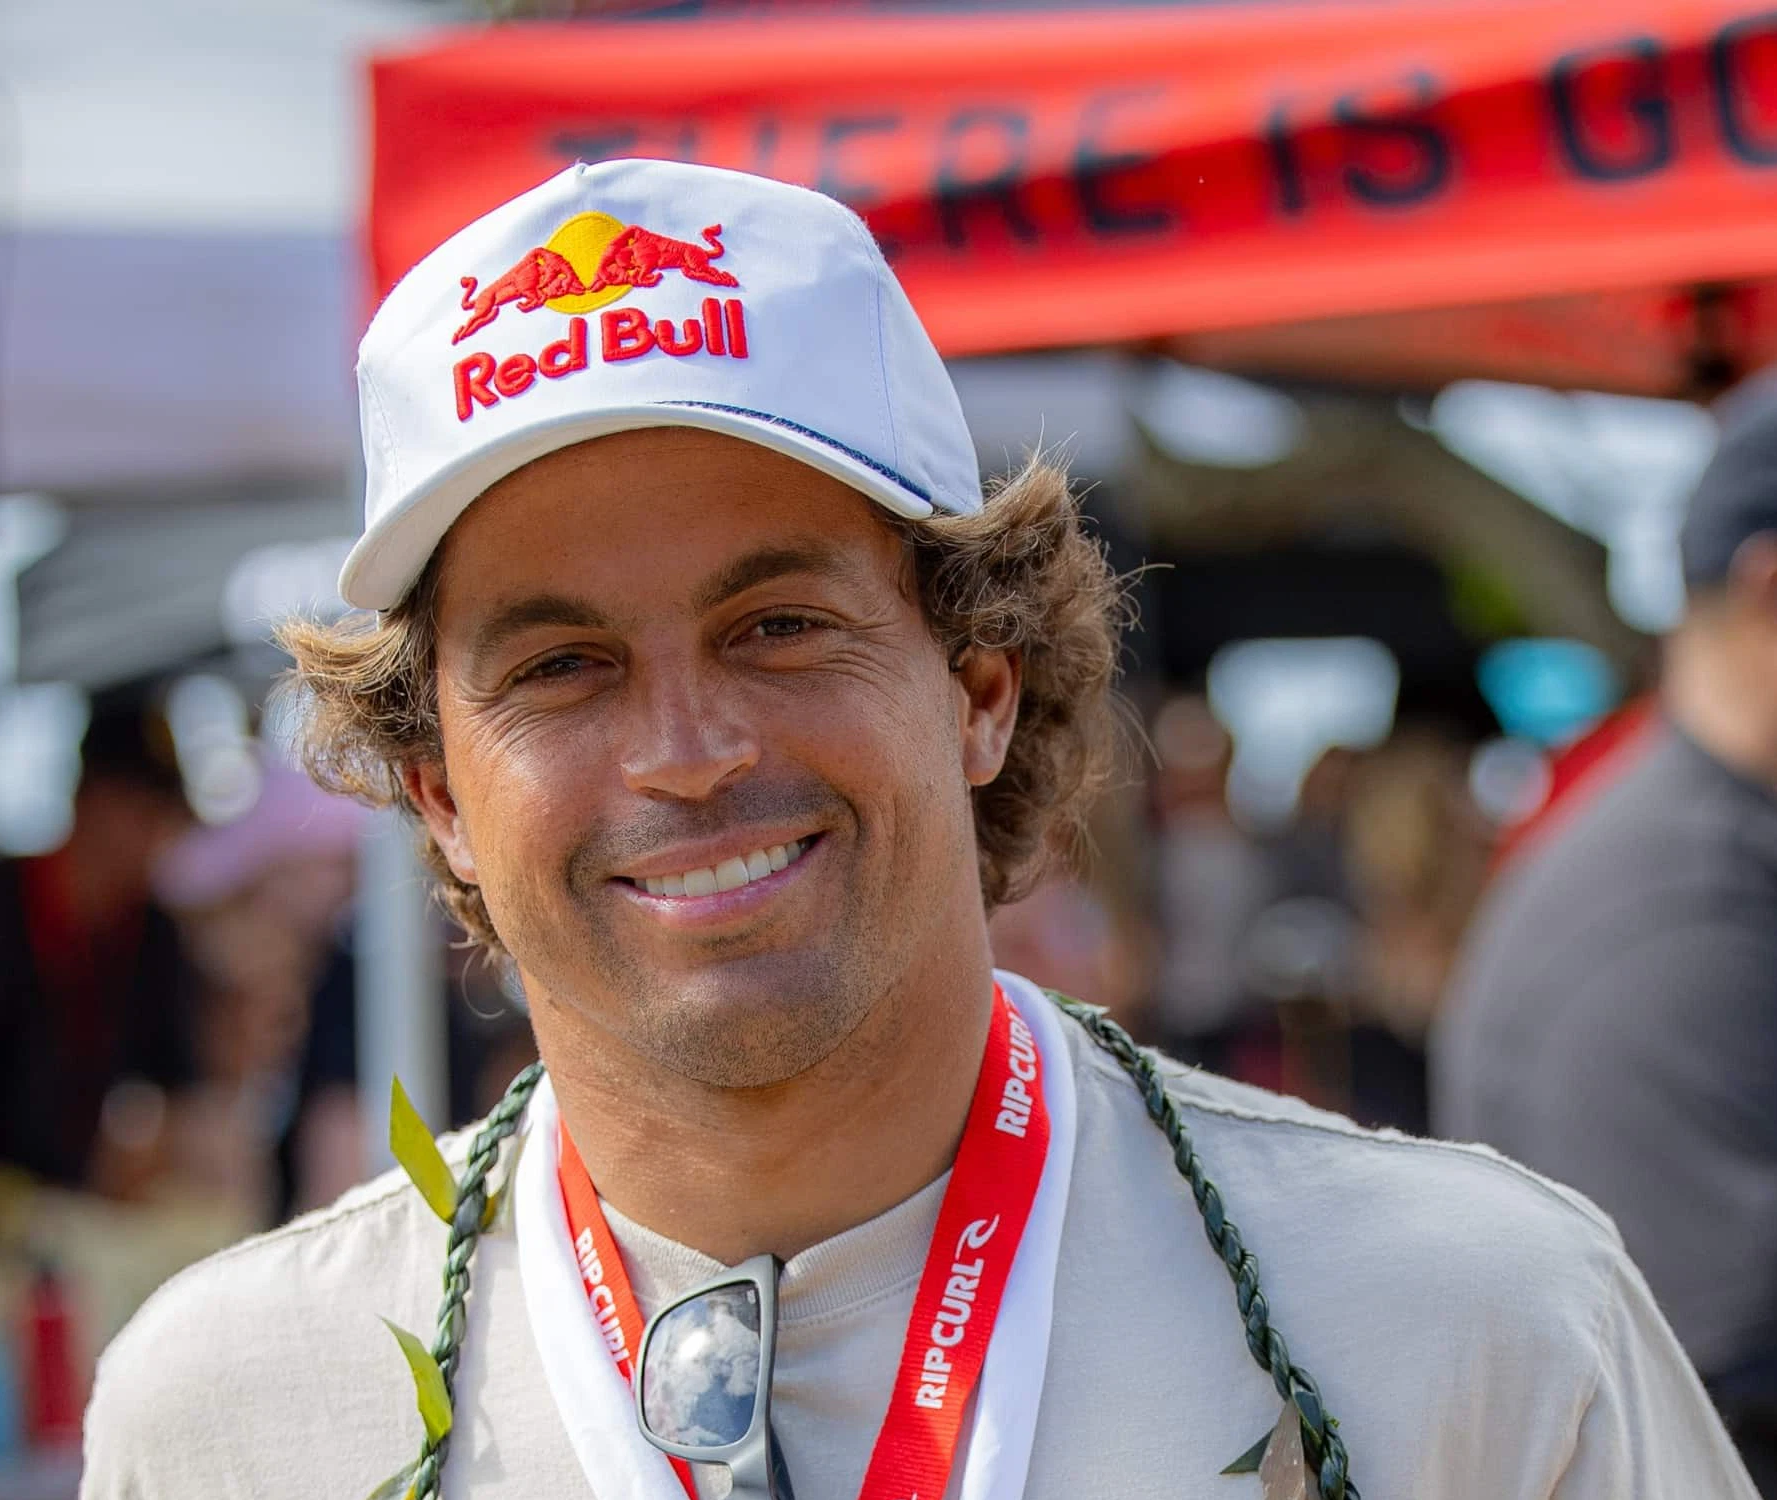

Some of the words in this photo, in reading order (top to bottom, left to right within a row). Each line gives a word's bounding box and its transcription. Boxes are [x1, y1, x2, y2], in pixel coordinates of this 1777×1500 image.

[552, 85, 1174, 254] ERE
[1260, 68, 1456, 216] IS
[453, 316, 588, 422] Red
[600, 297, 749, 363] Bull
